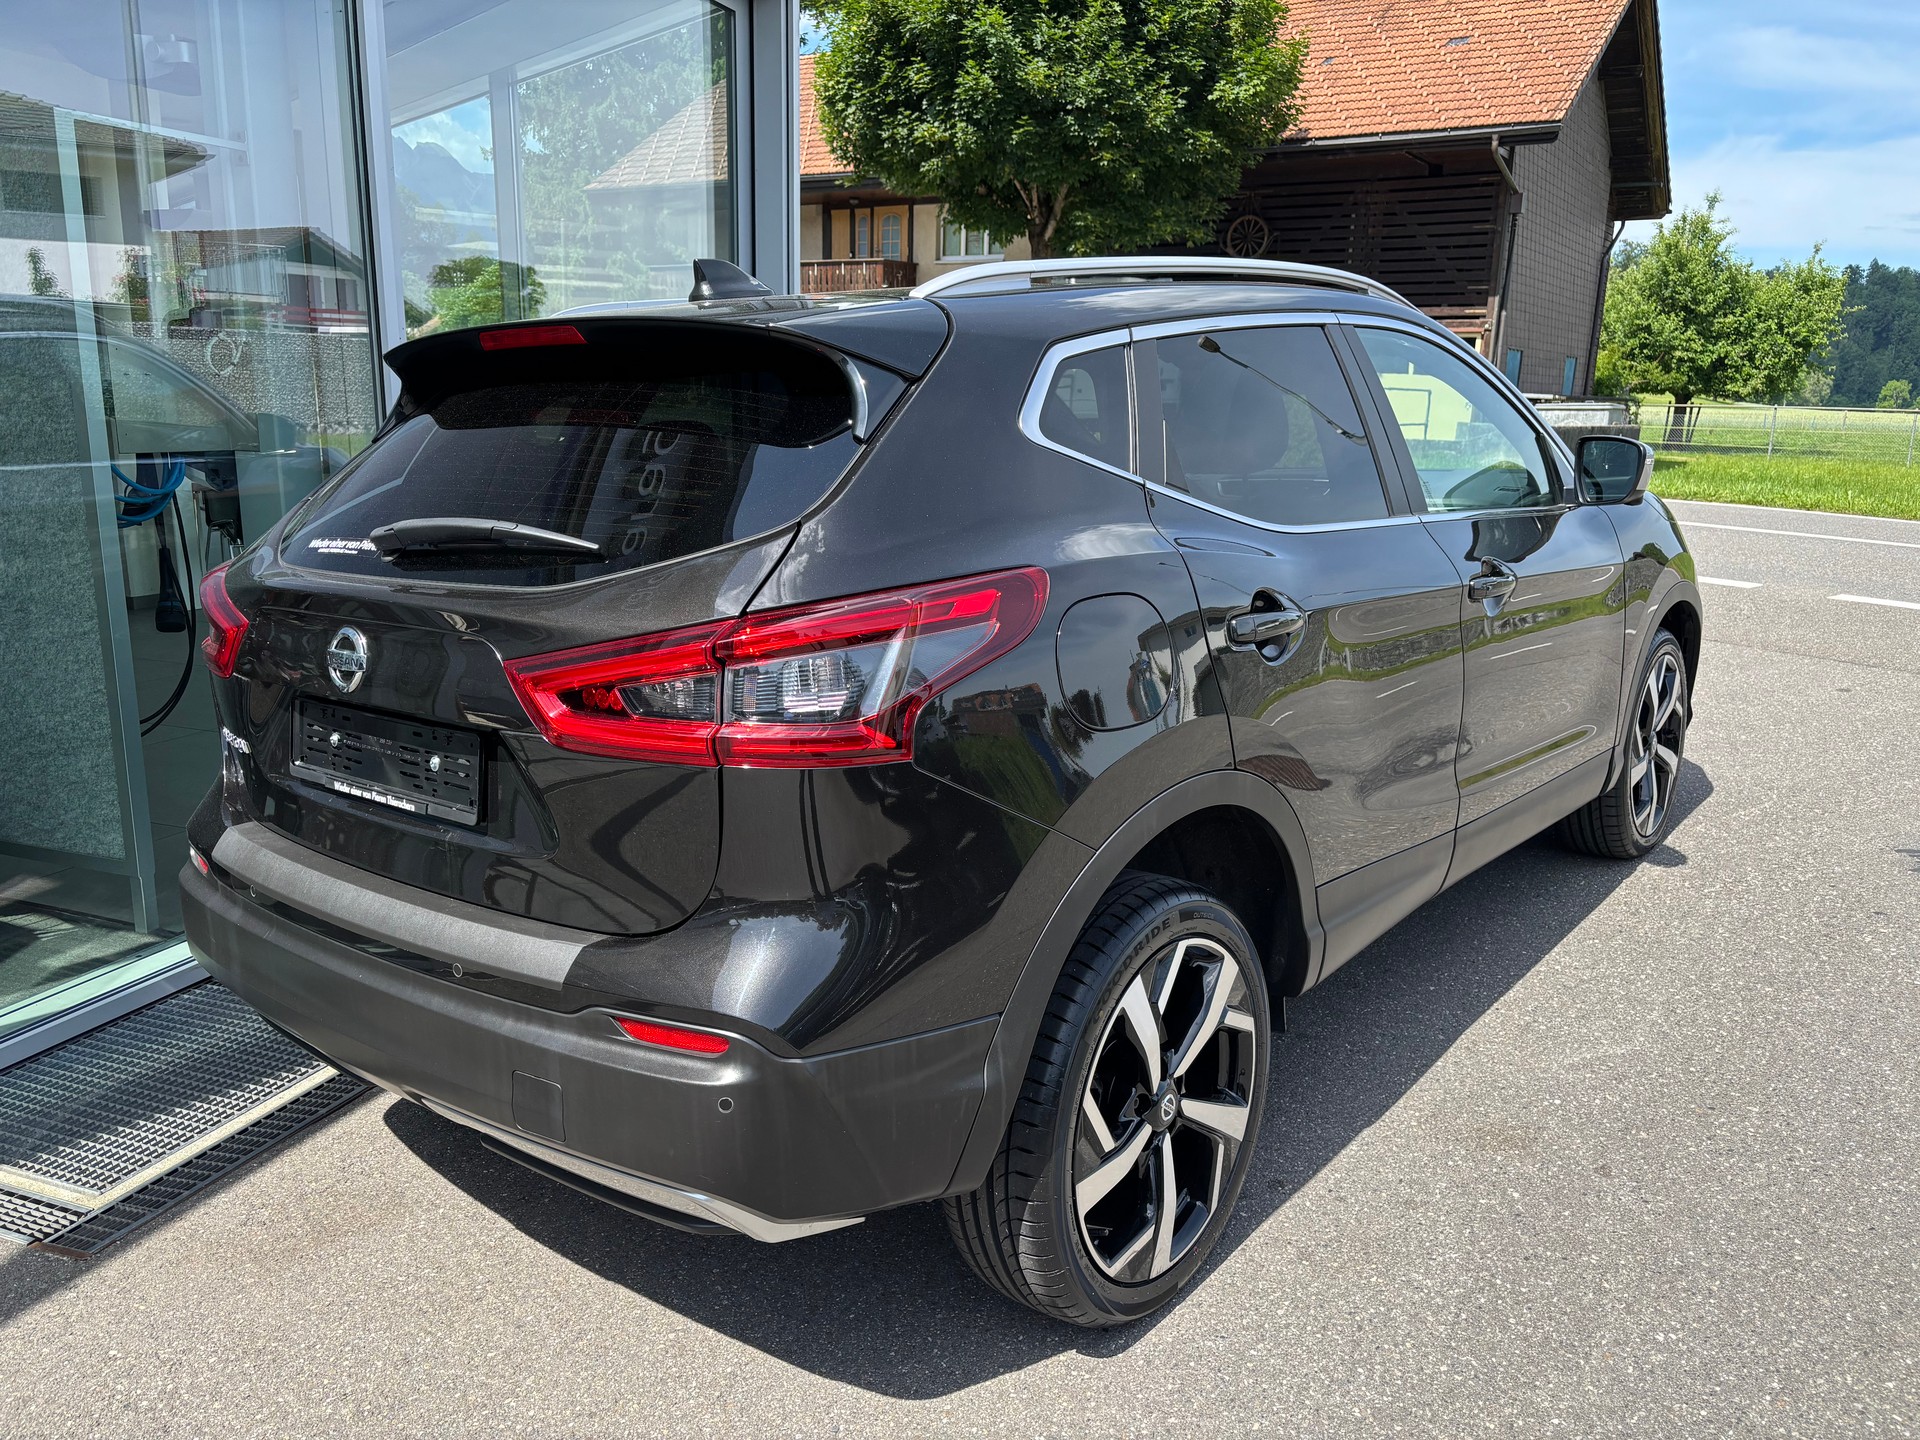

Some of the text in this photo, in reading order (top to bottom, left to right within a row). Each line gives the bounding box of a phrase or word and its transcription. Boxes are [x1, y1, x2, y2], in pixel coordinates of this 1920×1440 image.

[308, 539, 332, 548] Wieder
[329, 539, 347, 549] einer
[346, 541, 360, 549] von
[334, 781, 351, 793] Wieder
[350, 786, 362, 797] einer
[362, 791, 372, 800] von
[1193, 912, 1215, 920] OUTSIDE
